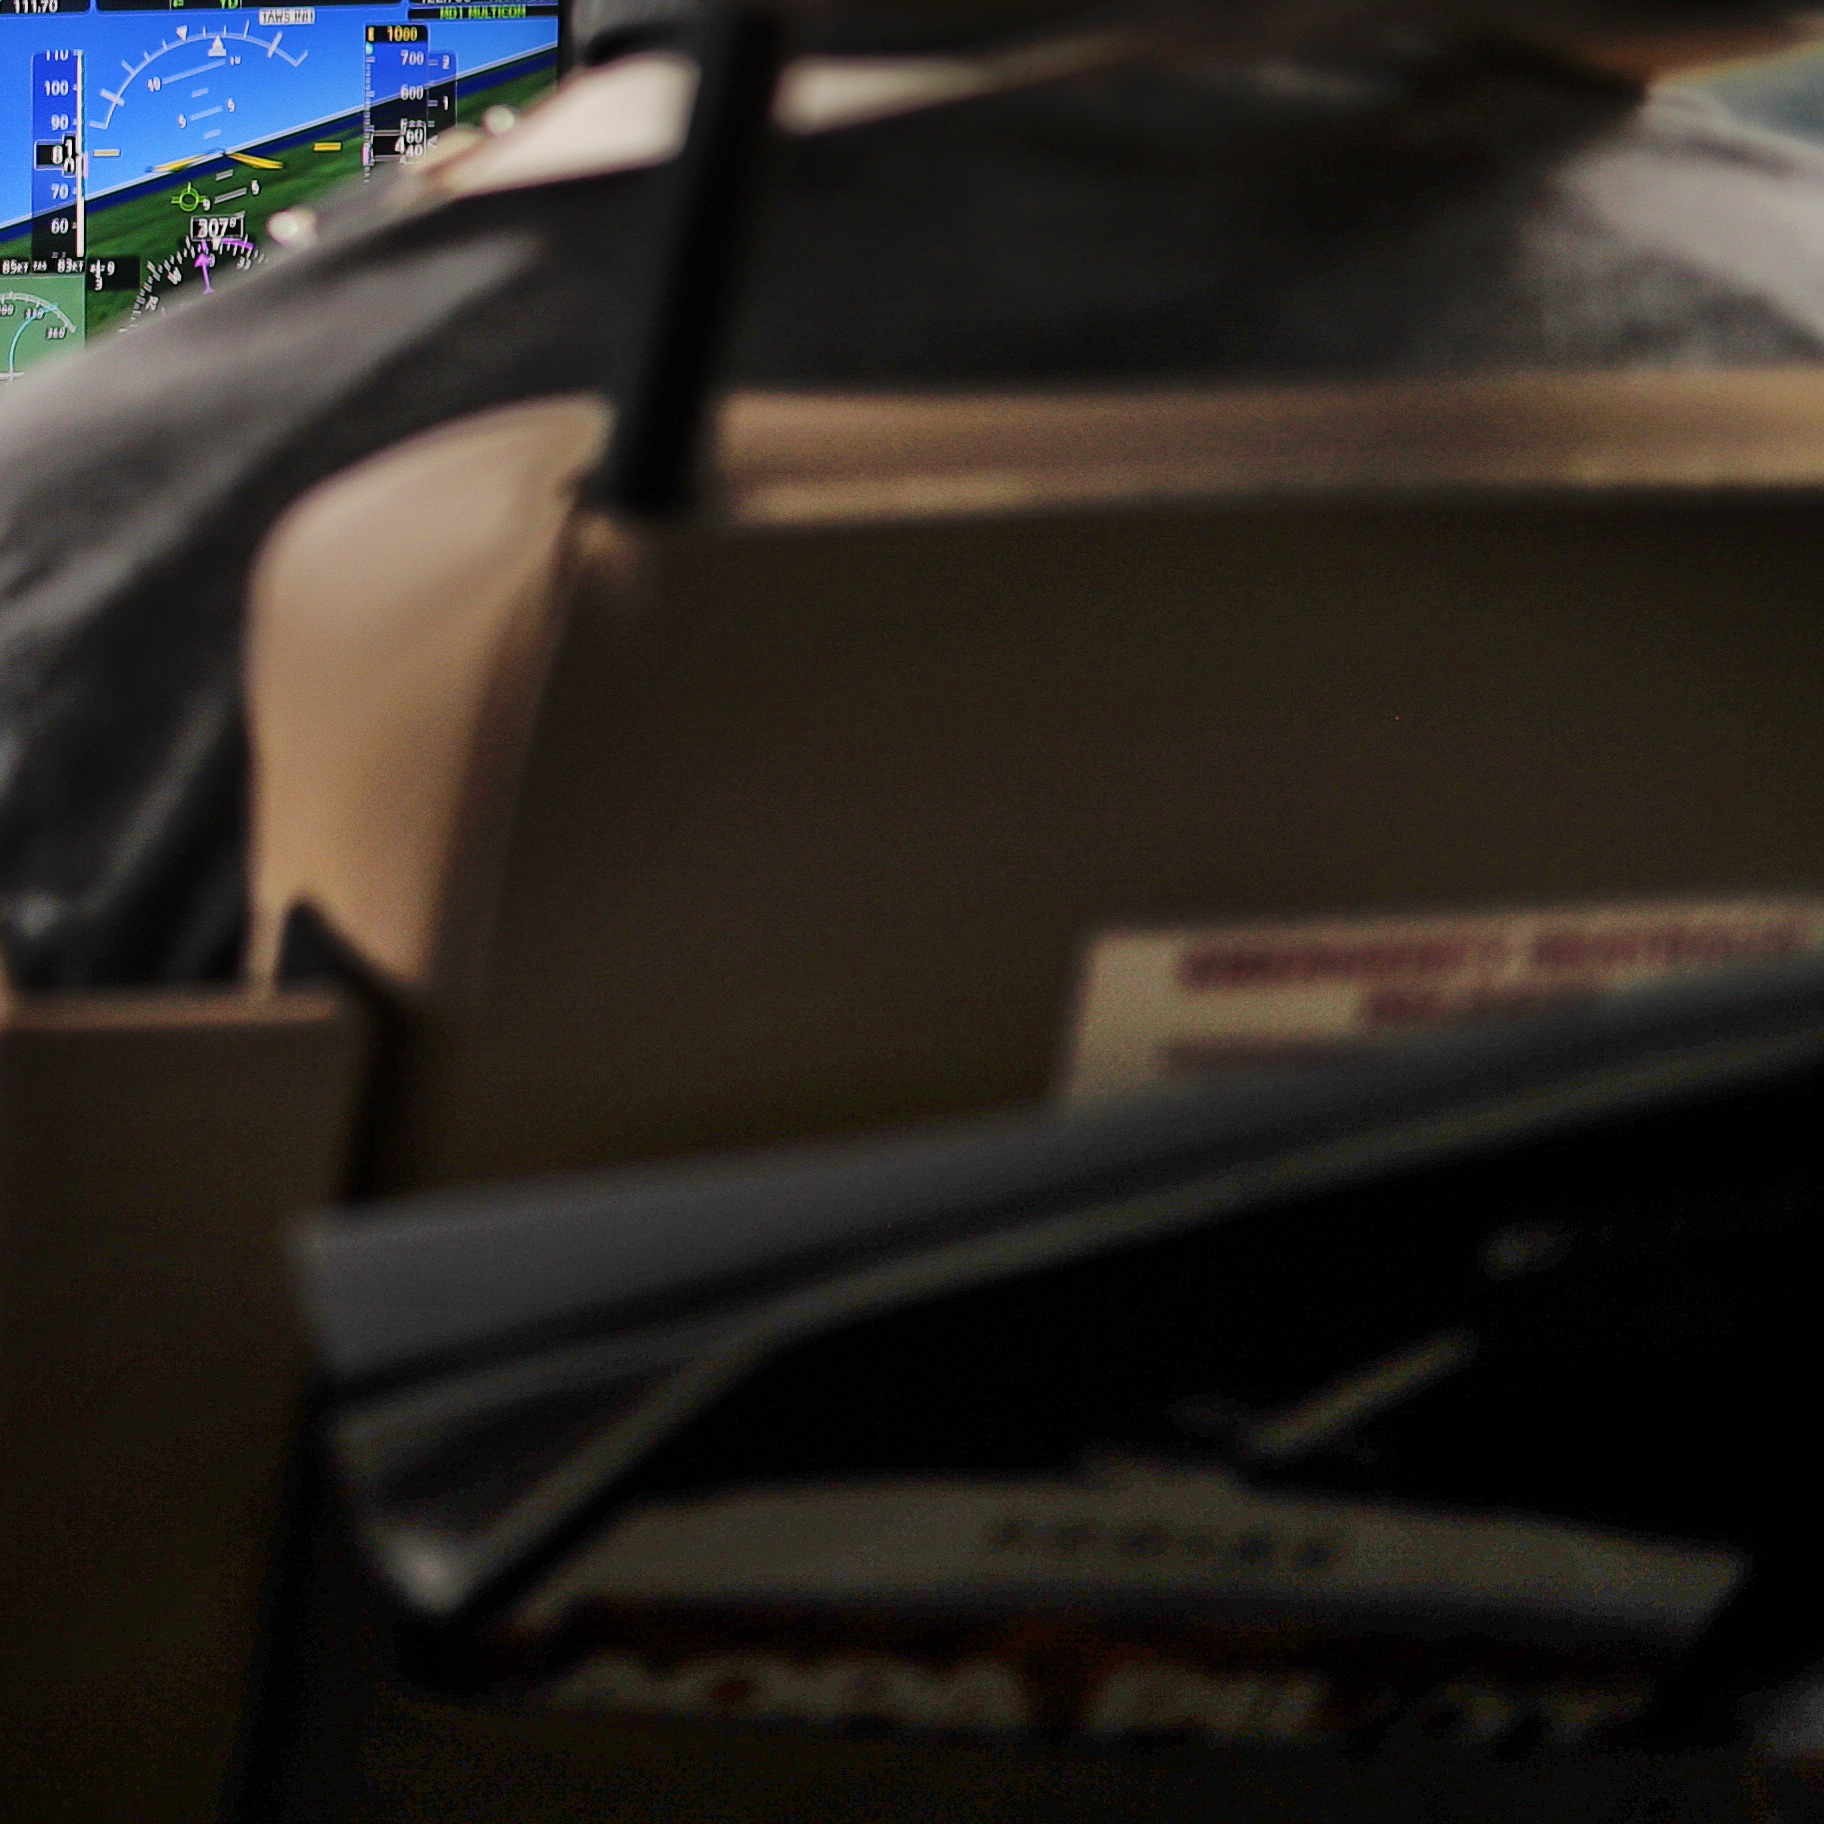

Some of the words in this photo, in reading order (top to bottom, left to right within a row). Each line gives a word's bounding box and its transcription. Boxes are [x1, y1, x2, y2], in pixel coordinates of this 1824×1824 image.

[468, 5, 526, 18] MULTICOM
[387, 27, 418, 42] 1000
[401, 50, 424, 65] 700
[44, 81, 69, 95] 100
[400, 85, 424, 100] 600
[51, 115, 69, 130] 90
[51, 185, 69, 199] 70
[51, 219, 69, 233] 60
